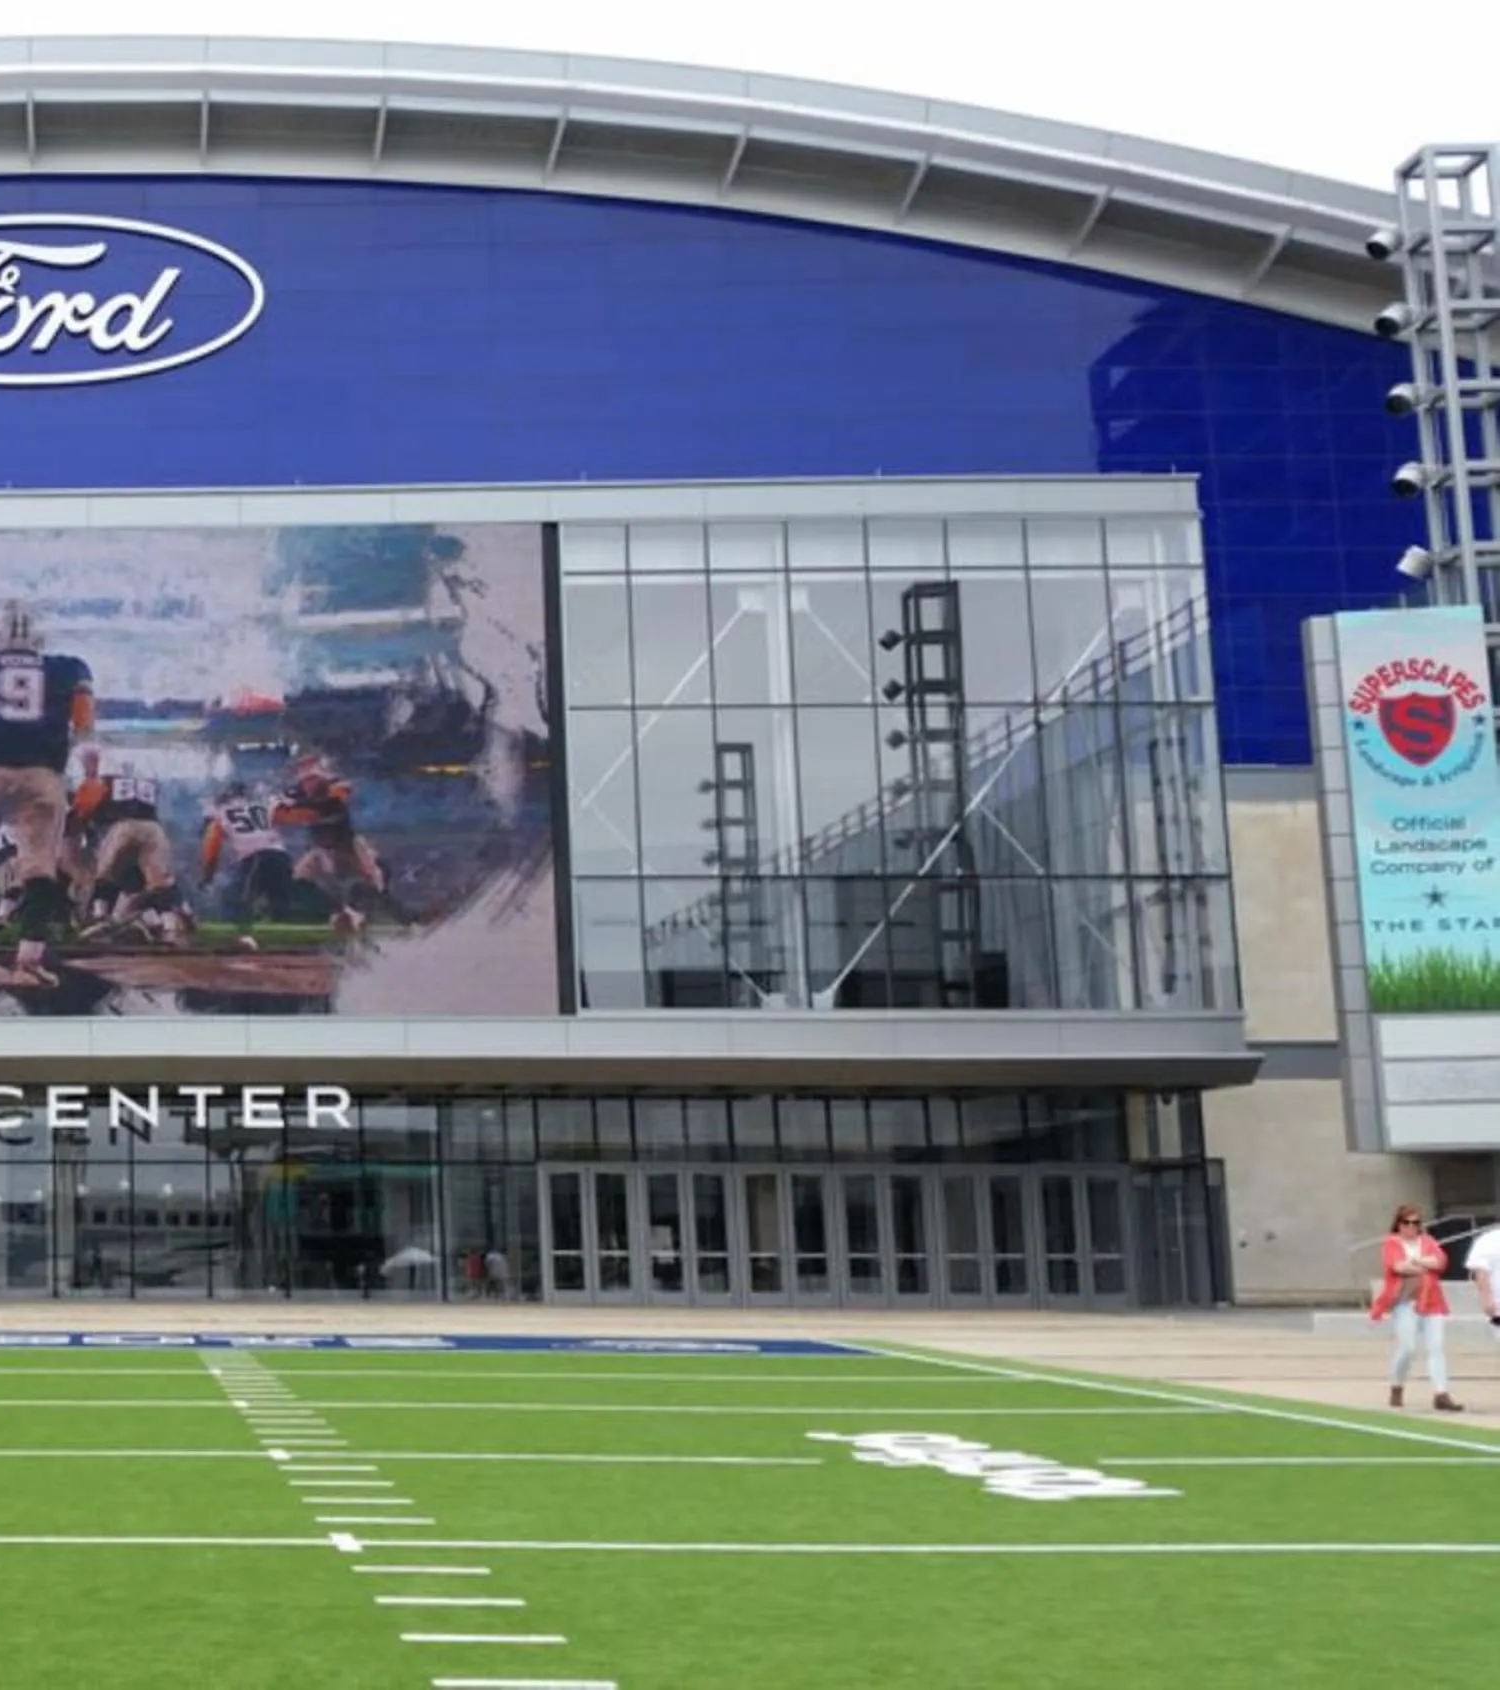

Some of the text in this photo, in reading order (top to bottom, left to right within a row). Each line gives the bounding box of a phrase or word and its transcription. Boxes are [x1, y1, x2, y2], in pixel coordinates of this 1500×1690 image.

[1349, 657, 1486, 714] SUPERSCAPES
[1391, 815, 1467, 831] Official
[1374, 838, 1488, 854] Landscape
[1369, 857, 1497, 876] Company of
[1370, 918, 1424, 933] THE
